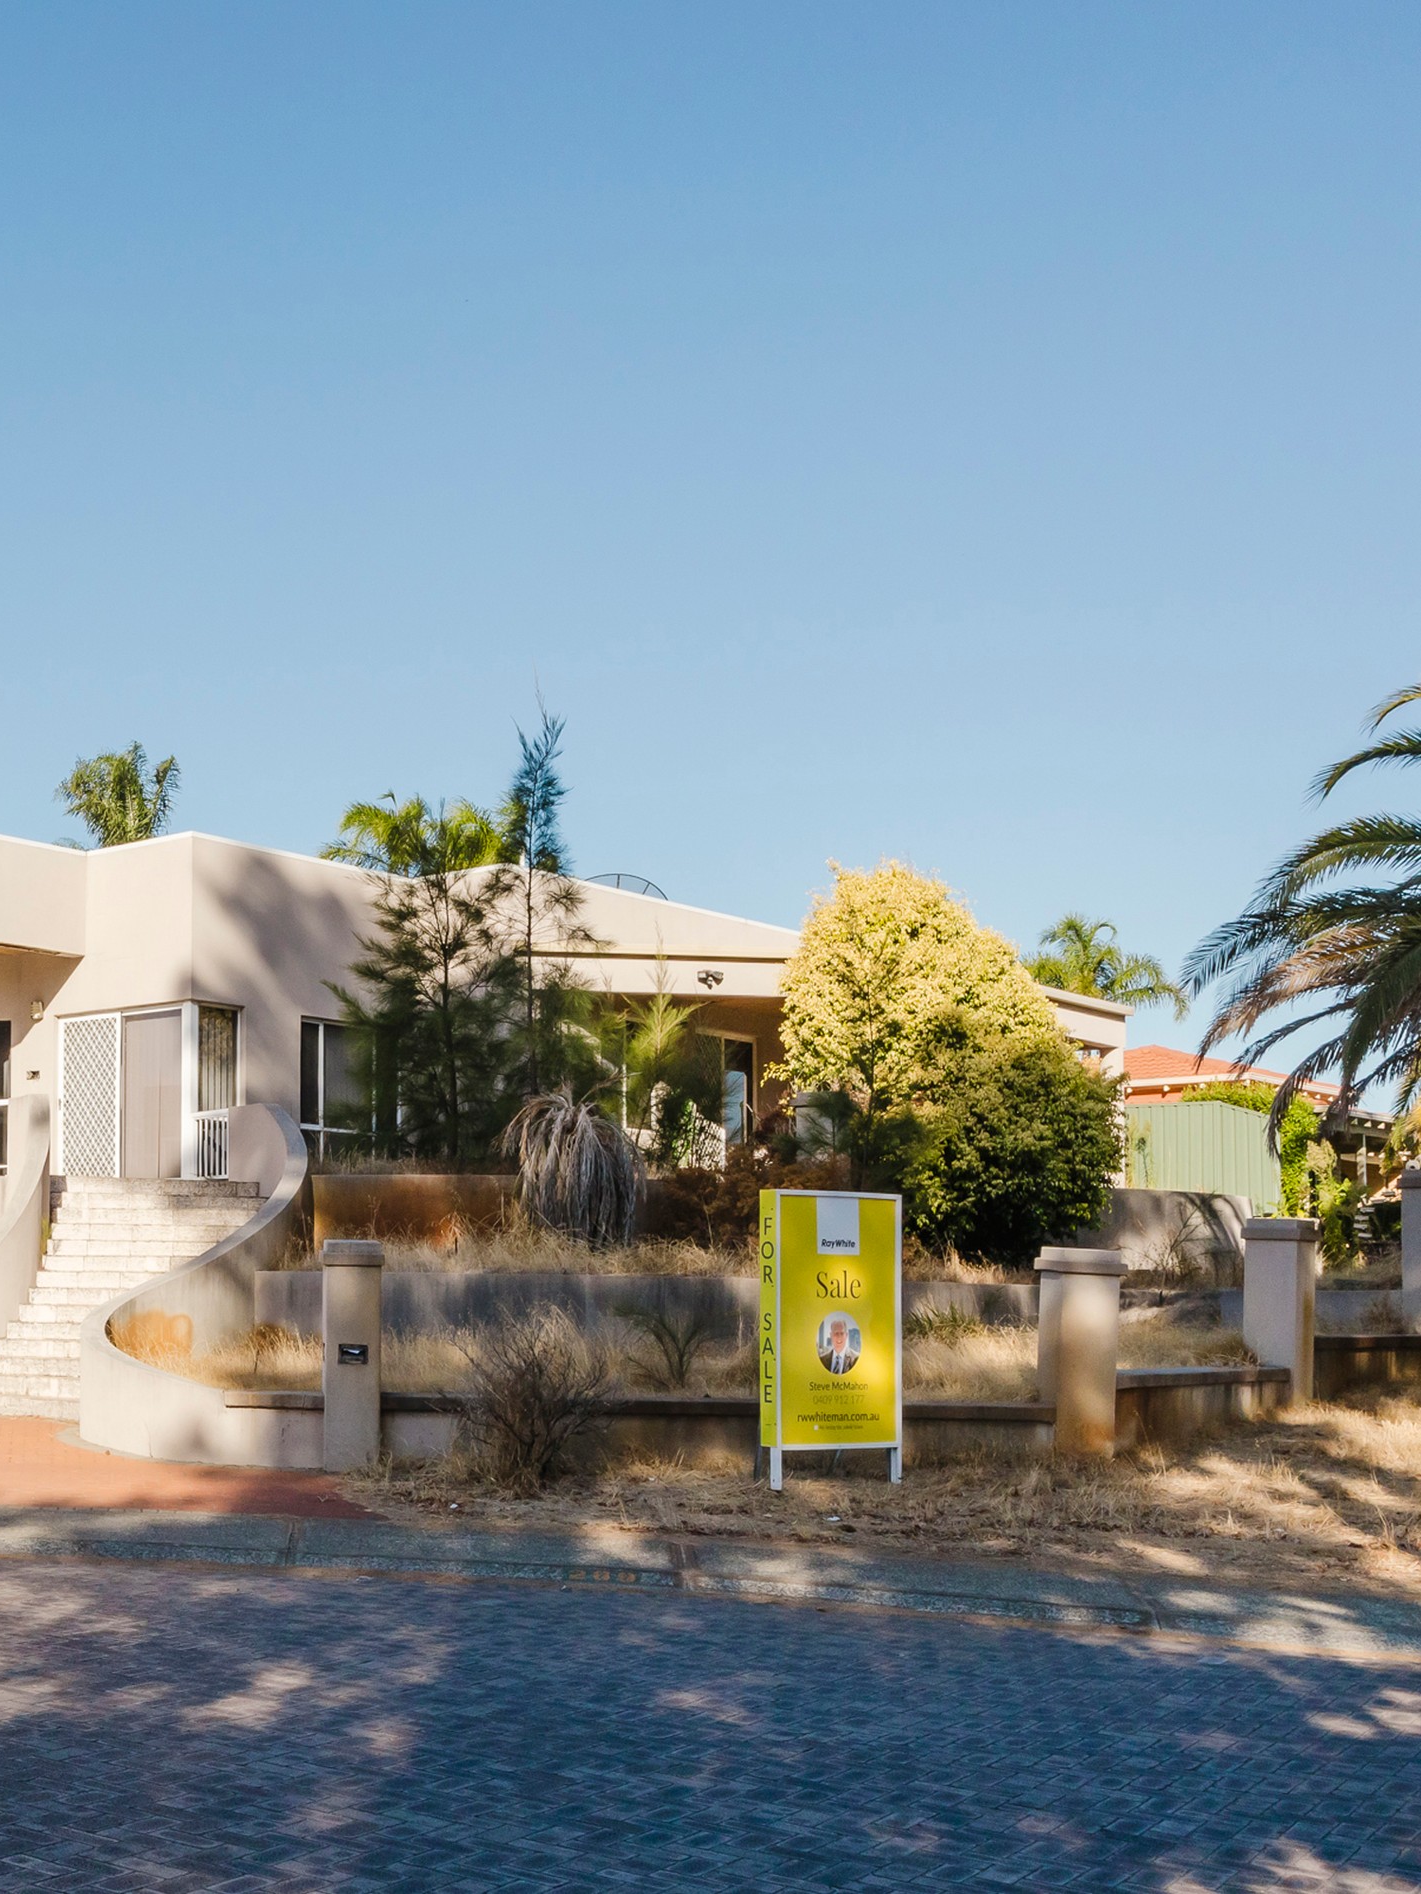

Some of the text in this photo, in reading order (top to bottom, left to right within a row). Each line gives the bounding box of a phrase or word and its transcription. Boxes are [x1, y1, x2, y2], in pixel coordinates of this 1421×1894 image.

[821, 1238, 856, 1249] RayWhite
[816, 1270, 861, 1299] Sale
[761, 1217, 774, 1403] FOR SALE
[809, 1381, 868, 1391] Steve McMahon
[812, 1394, 832, 1405] 0409
[851, 1394, 865, 1404] 177
[797, 1411, 880, 1422] rwwhiteman.com.au
